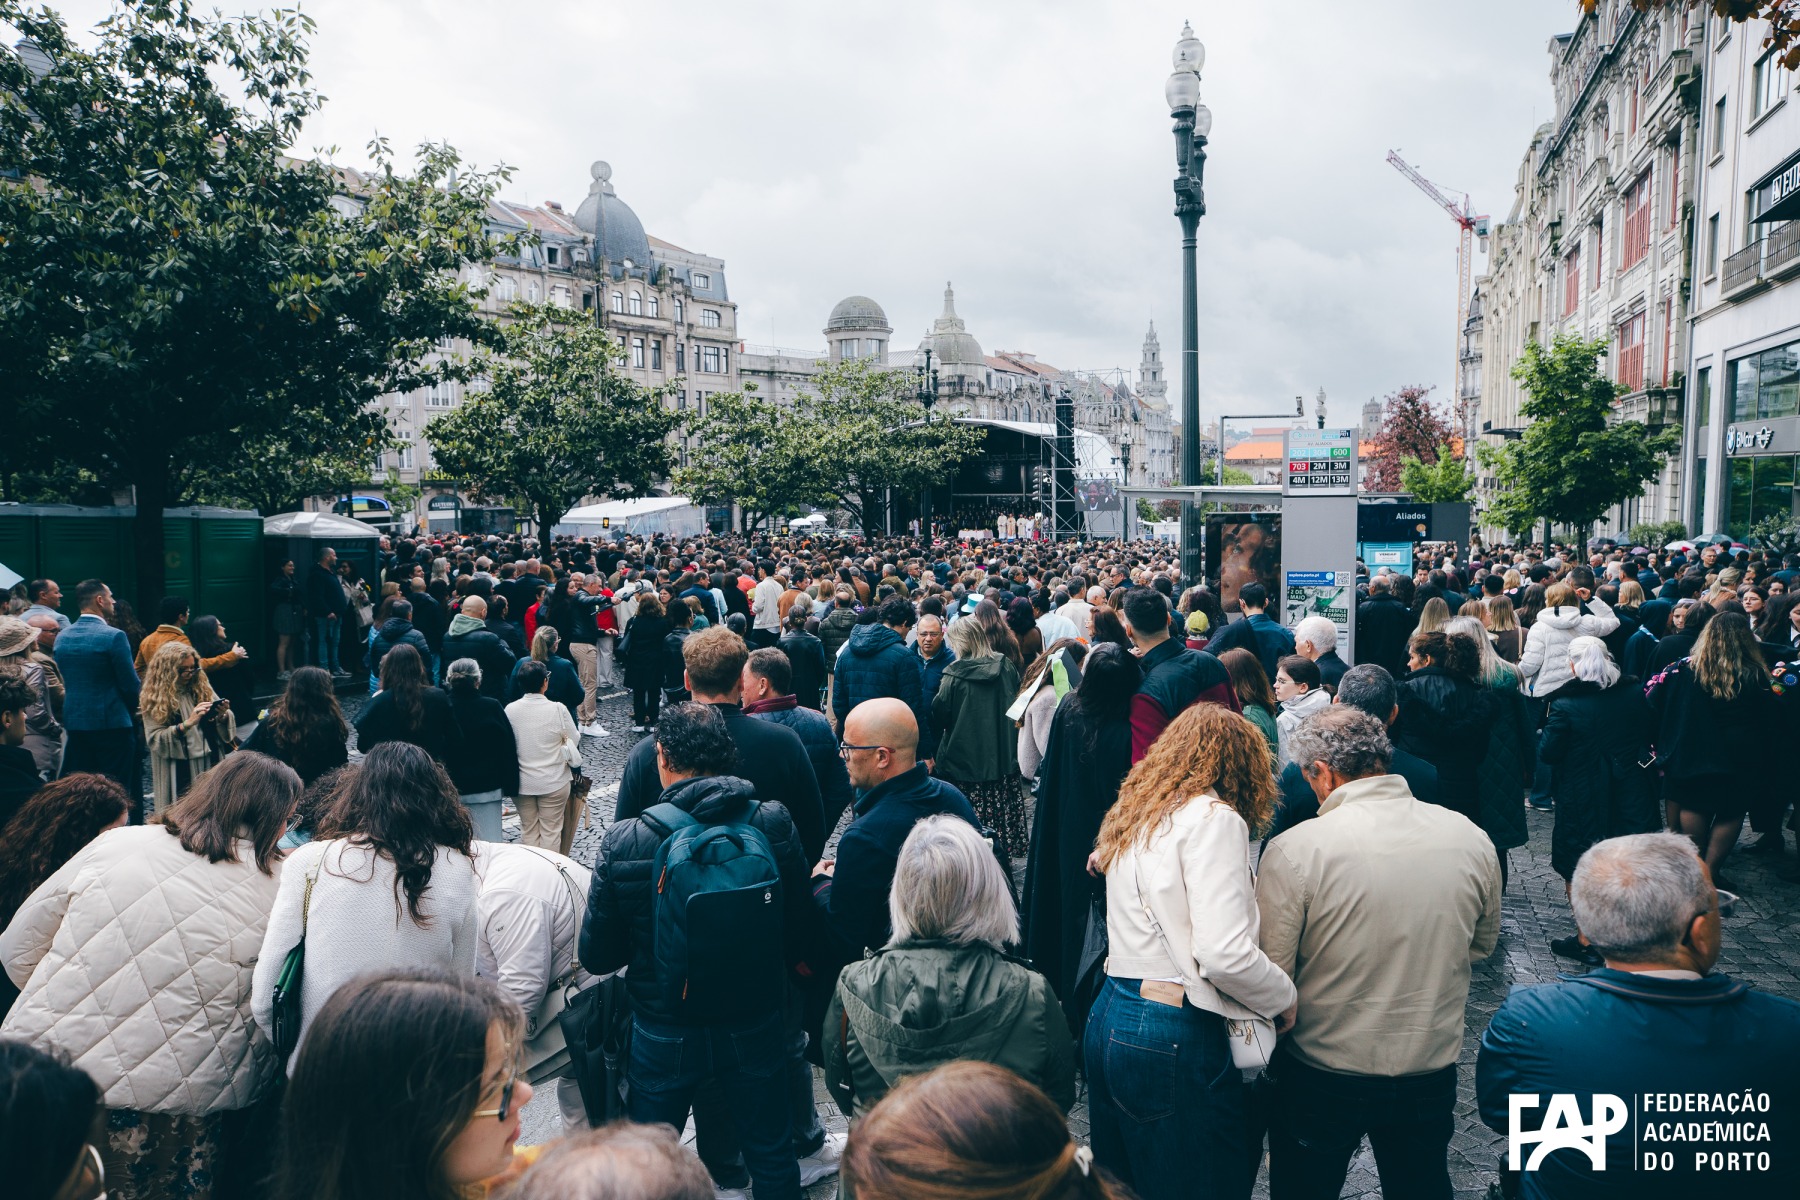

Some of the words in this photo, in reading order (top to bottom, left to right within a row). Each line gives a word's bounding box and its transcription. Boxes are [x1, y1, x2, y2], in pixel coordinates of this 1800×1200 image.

[1333, 448, 1348, 456] 600
[1292, 463, 1306, 471] 703
[1313, 462, 1326, 470] 2M
[1333, 462, 1347, 470] 3M
[1292, 476, 1306, 484] 4M
[1311, 476, 1328, 484] 12M
[1332, 475, 1349, 483] 13M
[1396, 512, 1426, 520] Aliados
